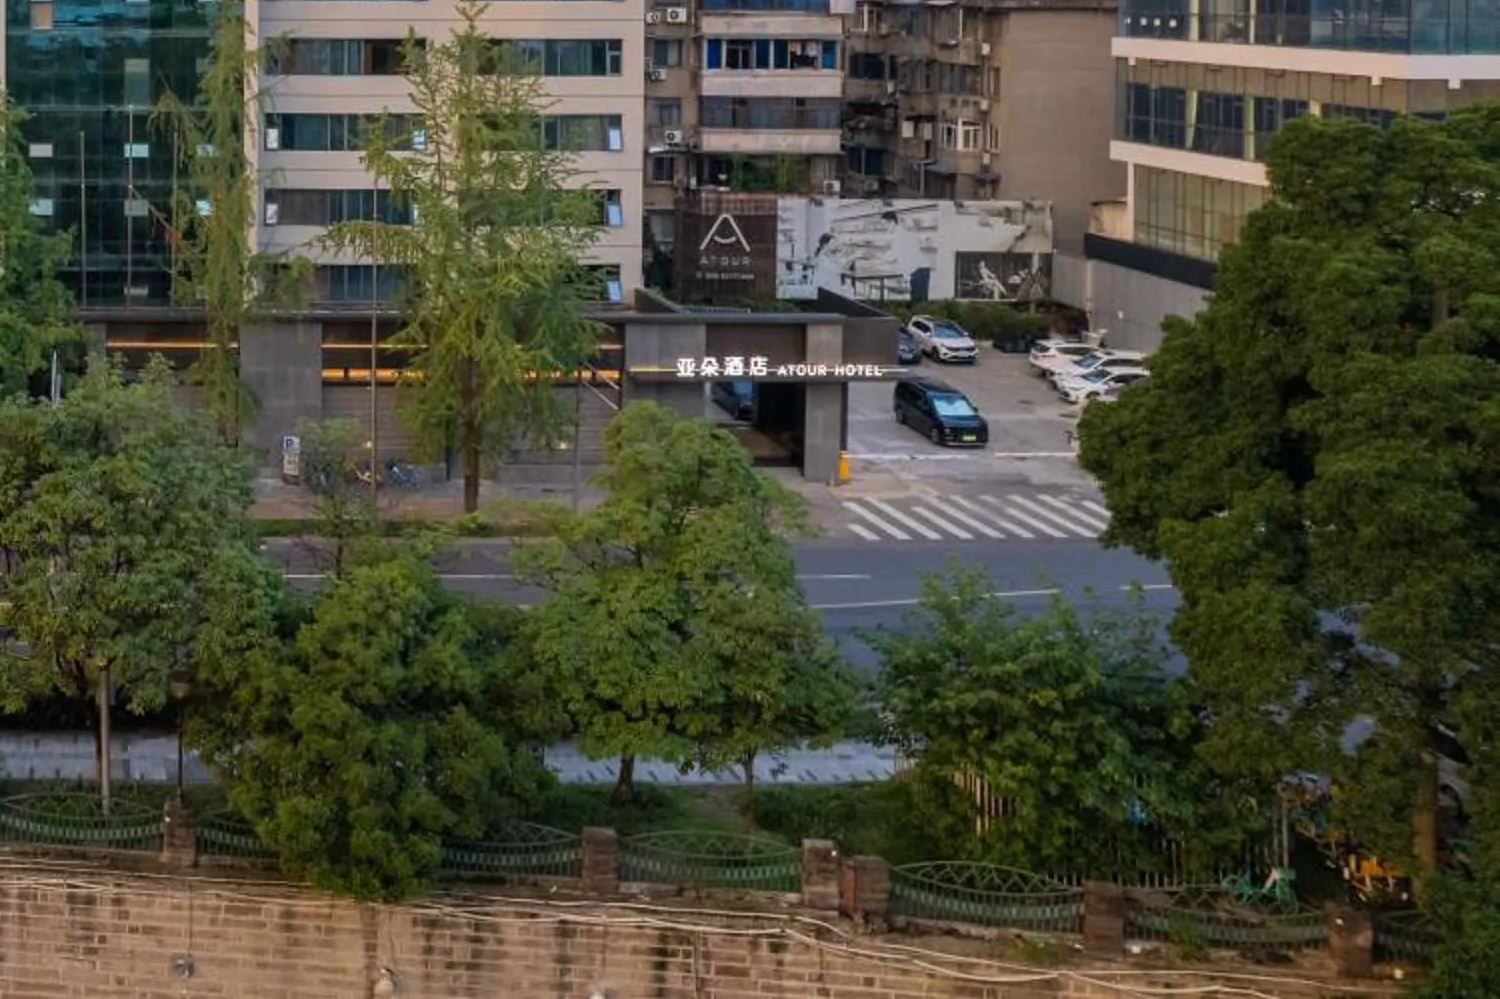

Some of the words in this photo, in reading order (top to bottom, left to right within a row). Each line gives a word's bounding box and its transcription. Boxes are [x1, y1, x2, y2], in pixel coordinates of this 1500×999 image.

[676, 356, 769, 377] 亚朵酒店
[776, 364, 827, 377] ATOUR
[834, 364, 883, 377] HOTEL
